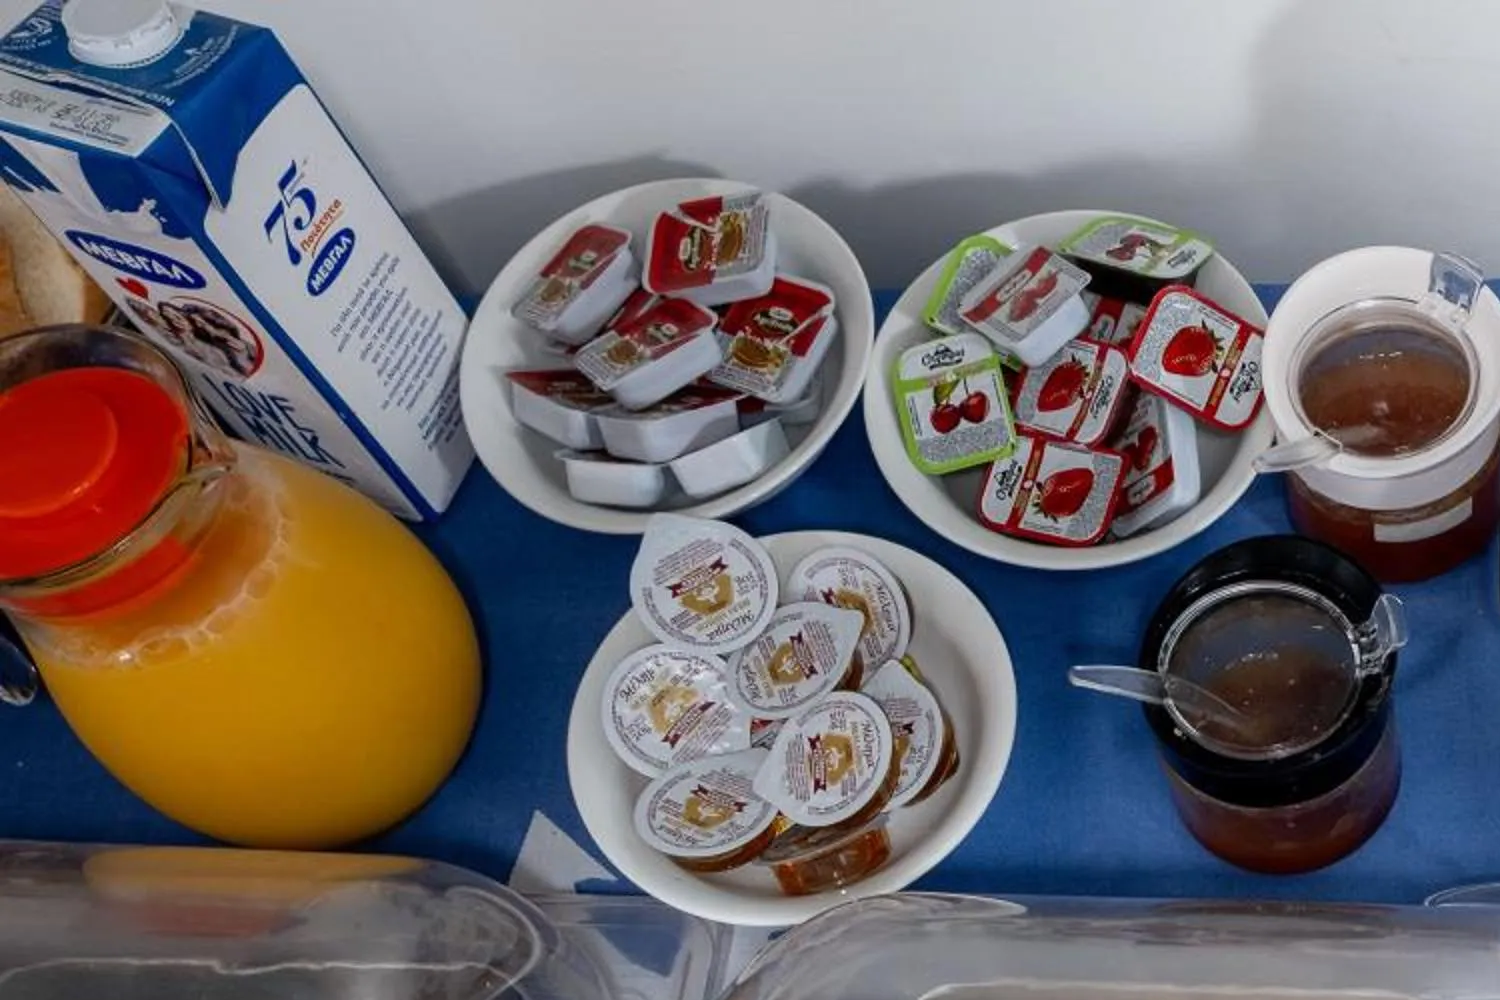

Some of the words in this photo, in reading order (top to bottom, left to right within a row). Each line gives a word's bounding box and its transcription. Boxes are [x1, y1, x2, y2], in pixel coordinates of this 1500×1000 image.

[263, 159, 318, 266] 75
[78, 237, 194, 286] ΜΕΒΓΑΛ
[309, 233, 353, 292] ΜΕΒΓΑΛ
